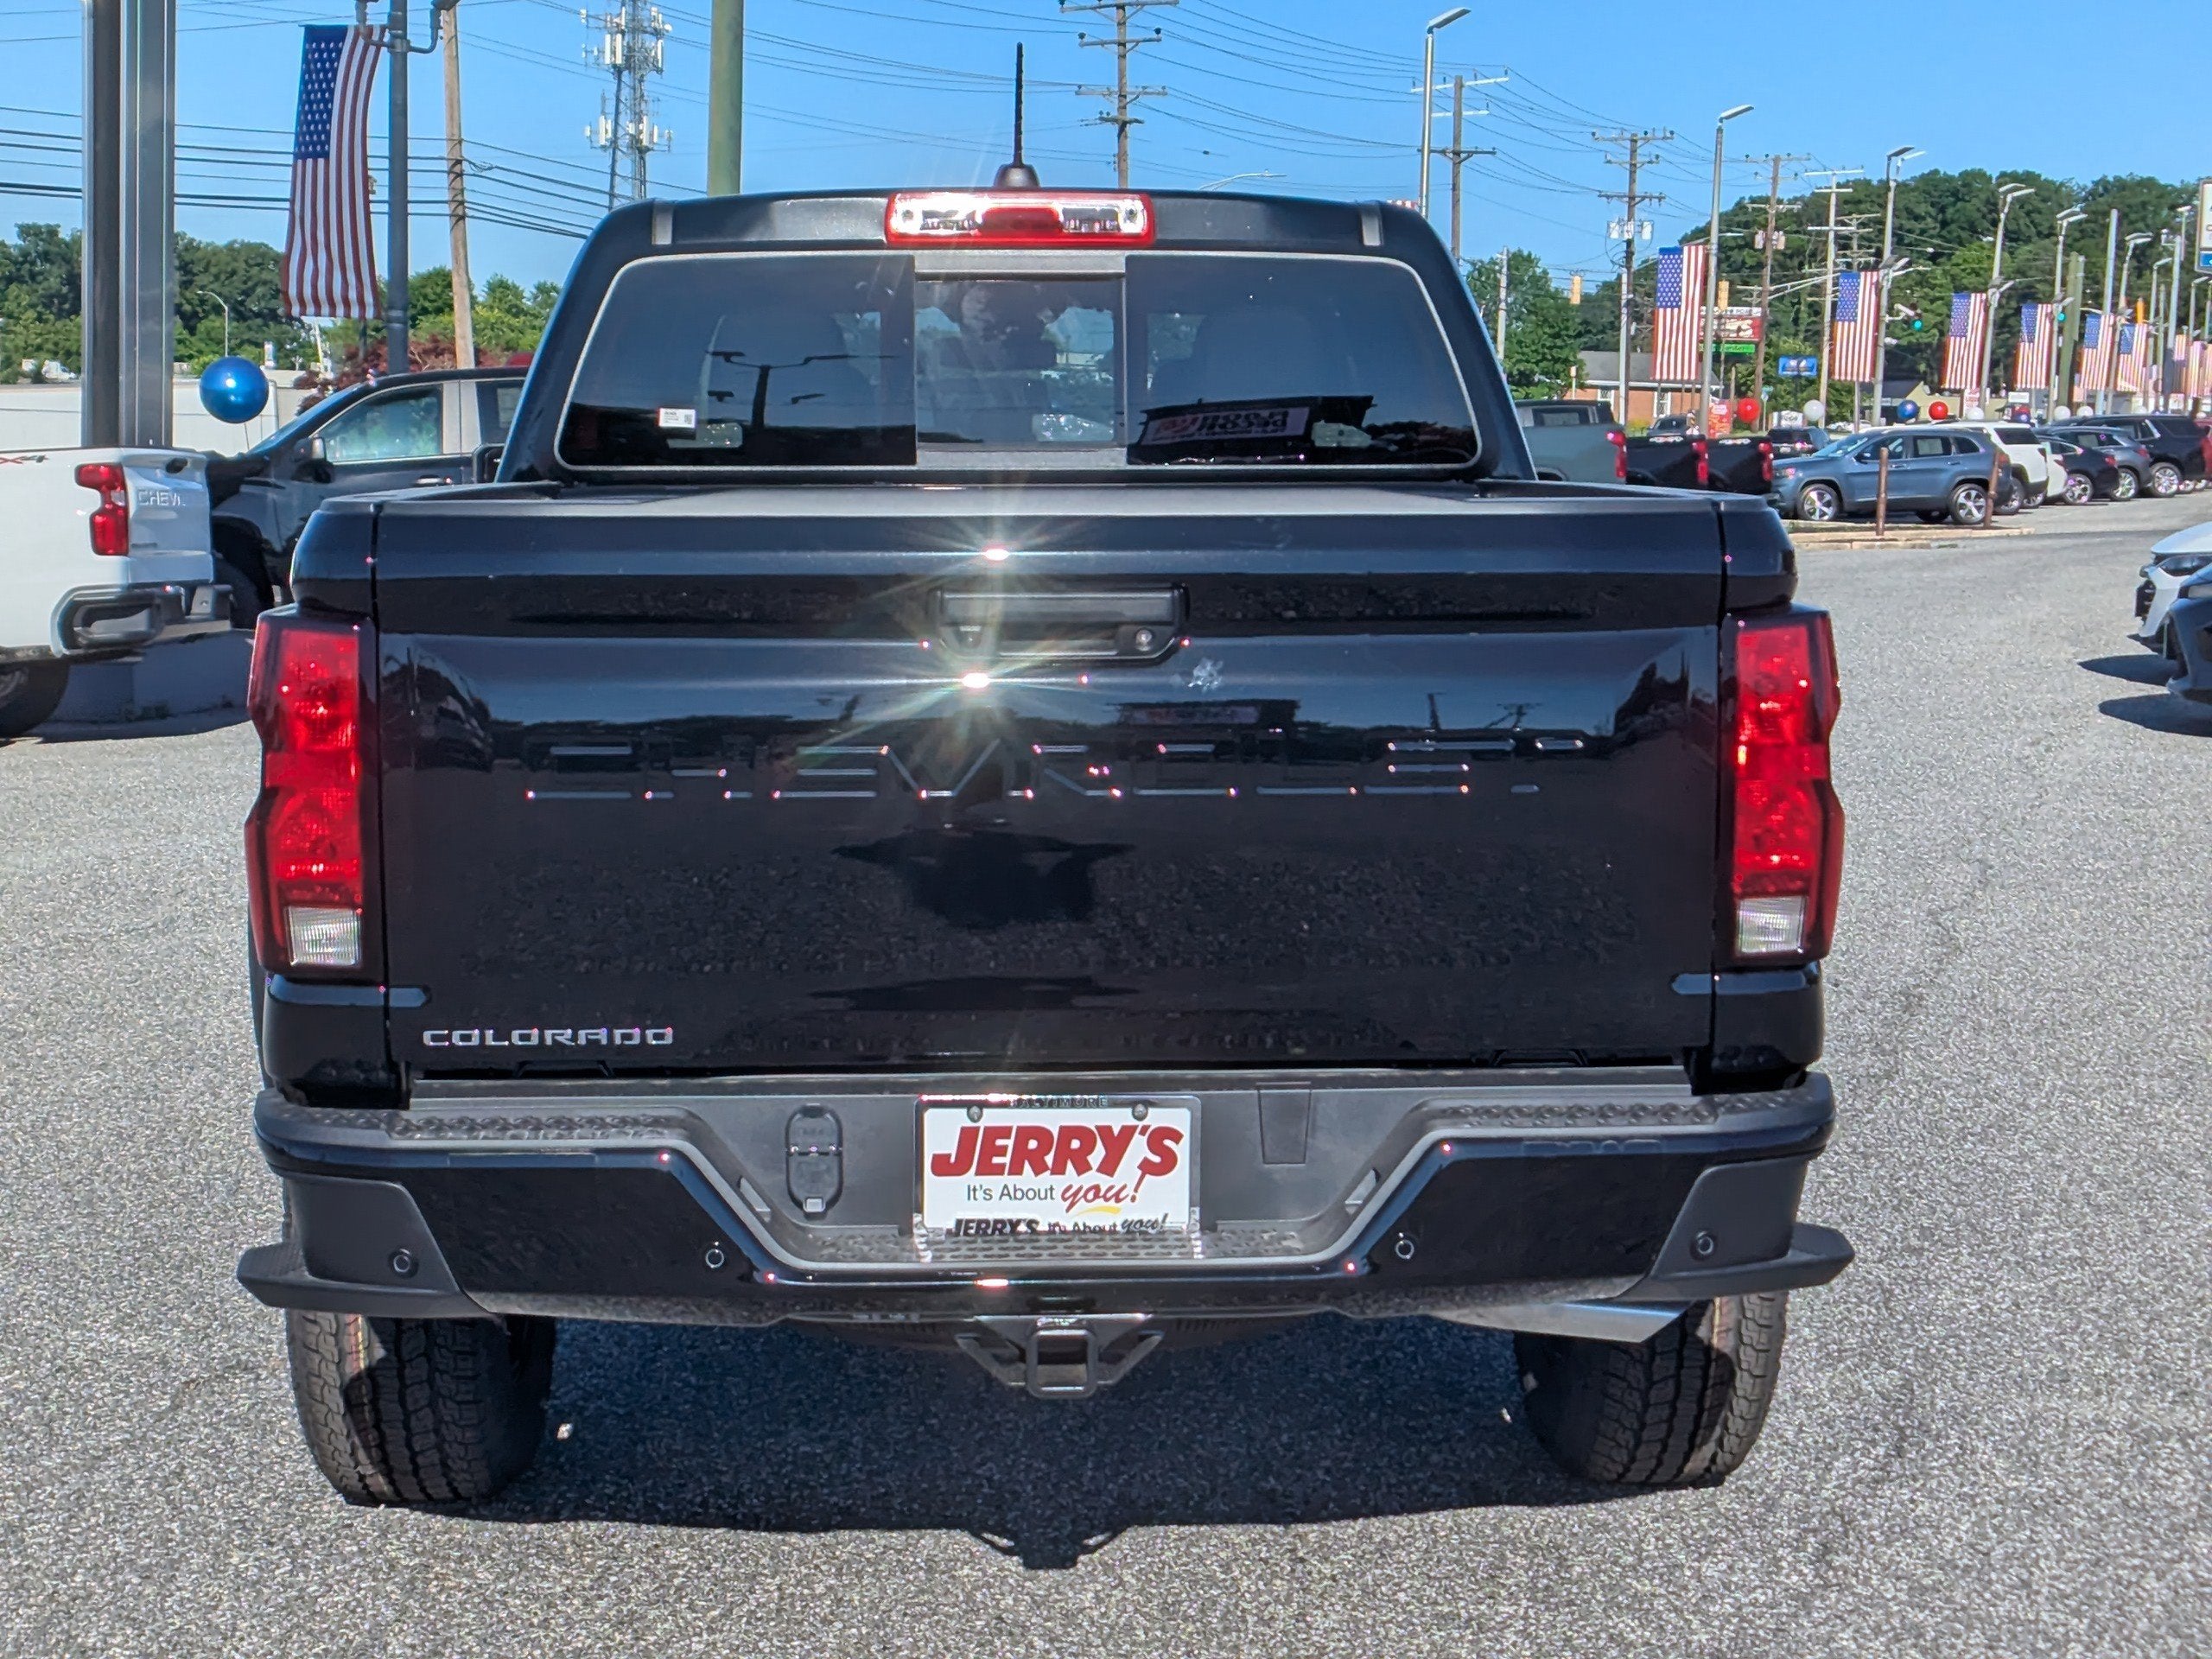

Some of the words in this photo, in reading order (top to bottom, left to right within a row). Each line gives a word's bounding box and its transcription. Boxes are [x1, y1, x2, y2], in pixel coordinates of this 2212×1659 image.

[422, 1027, 674, 1046] COLORADO
[930, 1124, 1185, 1178] JERRY'S
[966, 1184, 993, 1201] It's
[999, 1184, 1055, 1201] About
[1060, 1173, 1147, 1214] you!
[953, 1217, 1040, 1236] JERRY'S
[1071, 1220, 1118, 1235] About
[1120, 1212, 1169, 1233] you!
